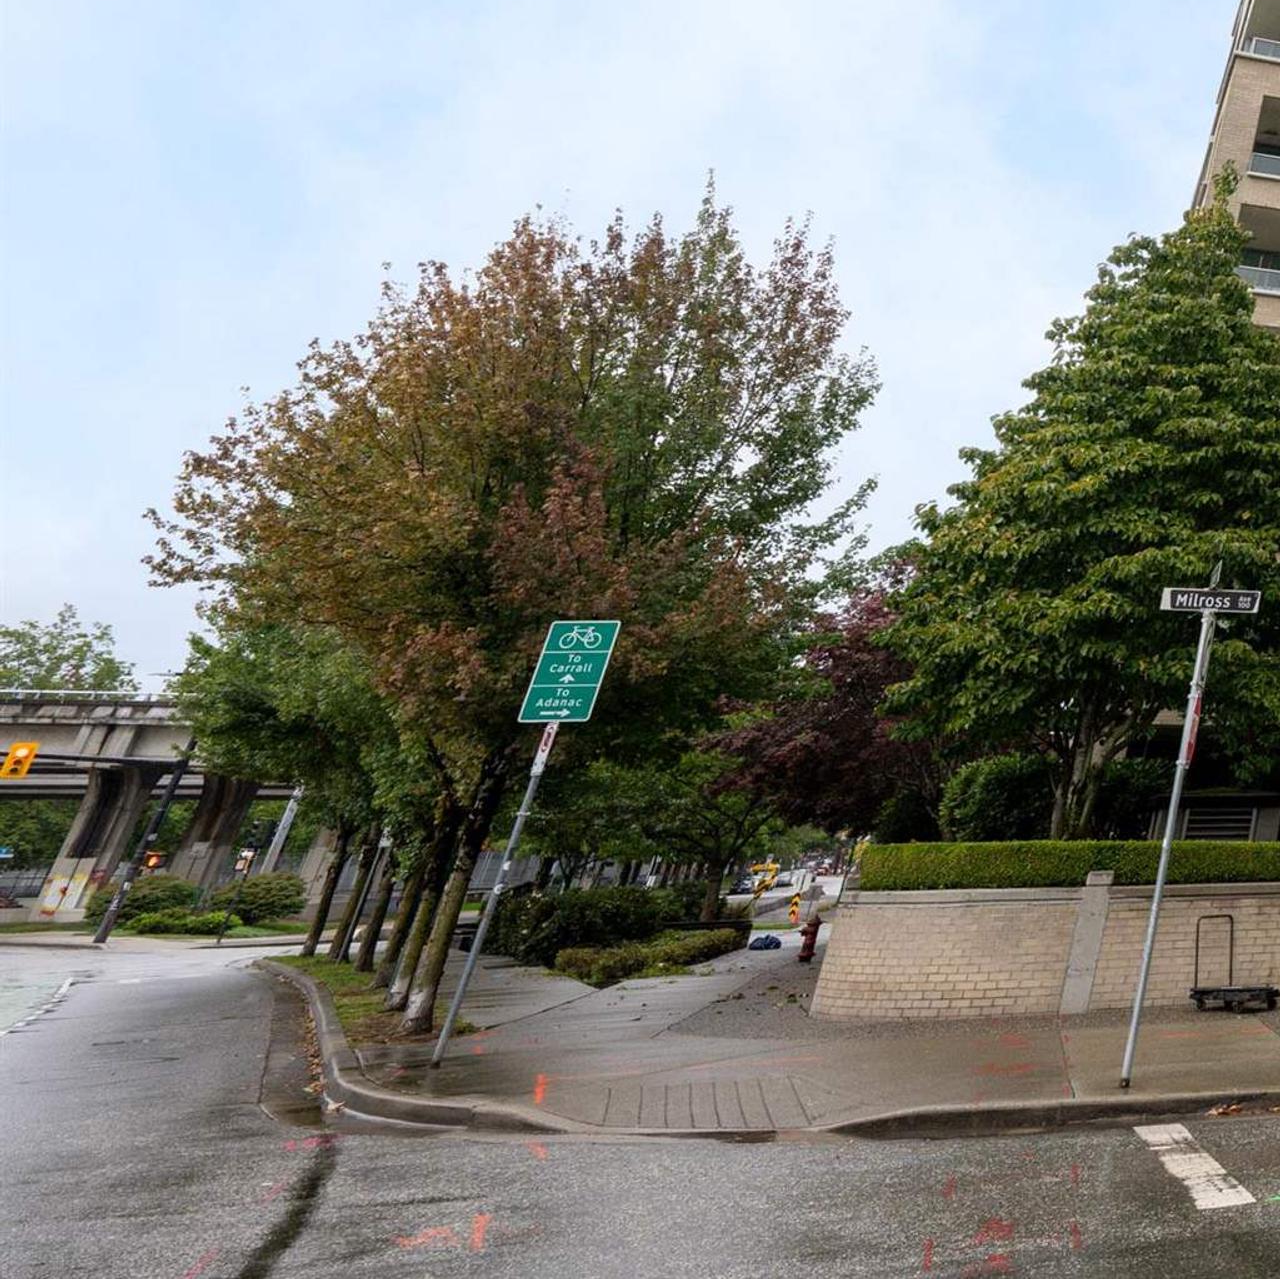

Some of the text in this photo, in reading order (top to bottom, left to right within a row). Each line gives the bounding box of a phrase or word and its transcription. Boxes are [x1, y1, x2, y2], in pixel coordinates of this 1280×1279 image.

[1175, 593, 1231, 609] Milross
[567, 654, 582, 663] To
[550, 663, 593, 673] Carrall
[555, 688, 570, 697] To
[535, 698, 583, 707] Adanac
